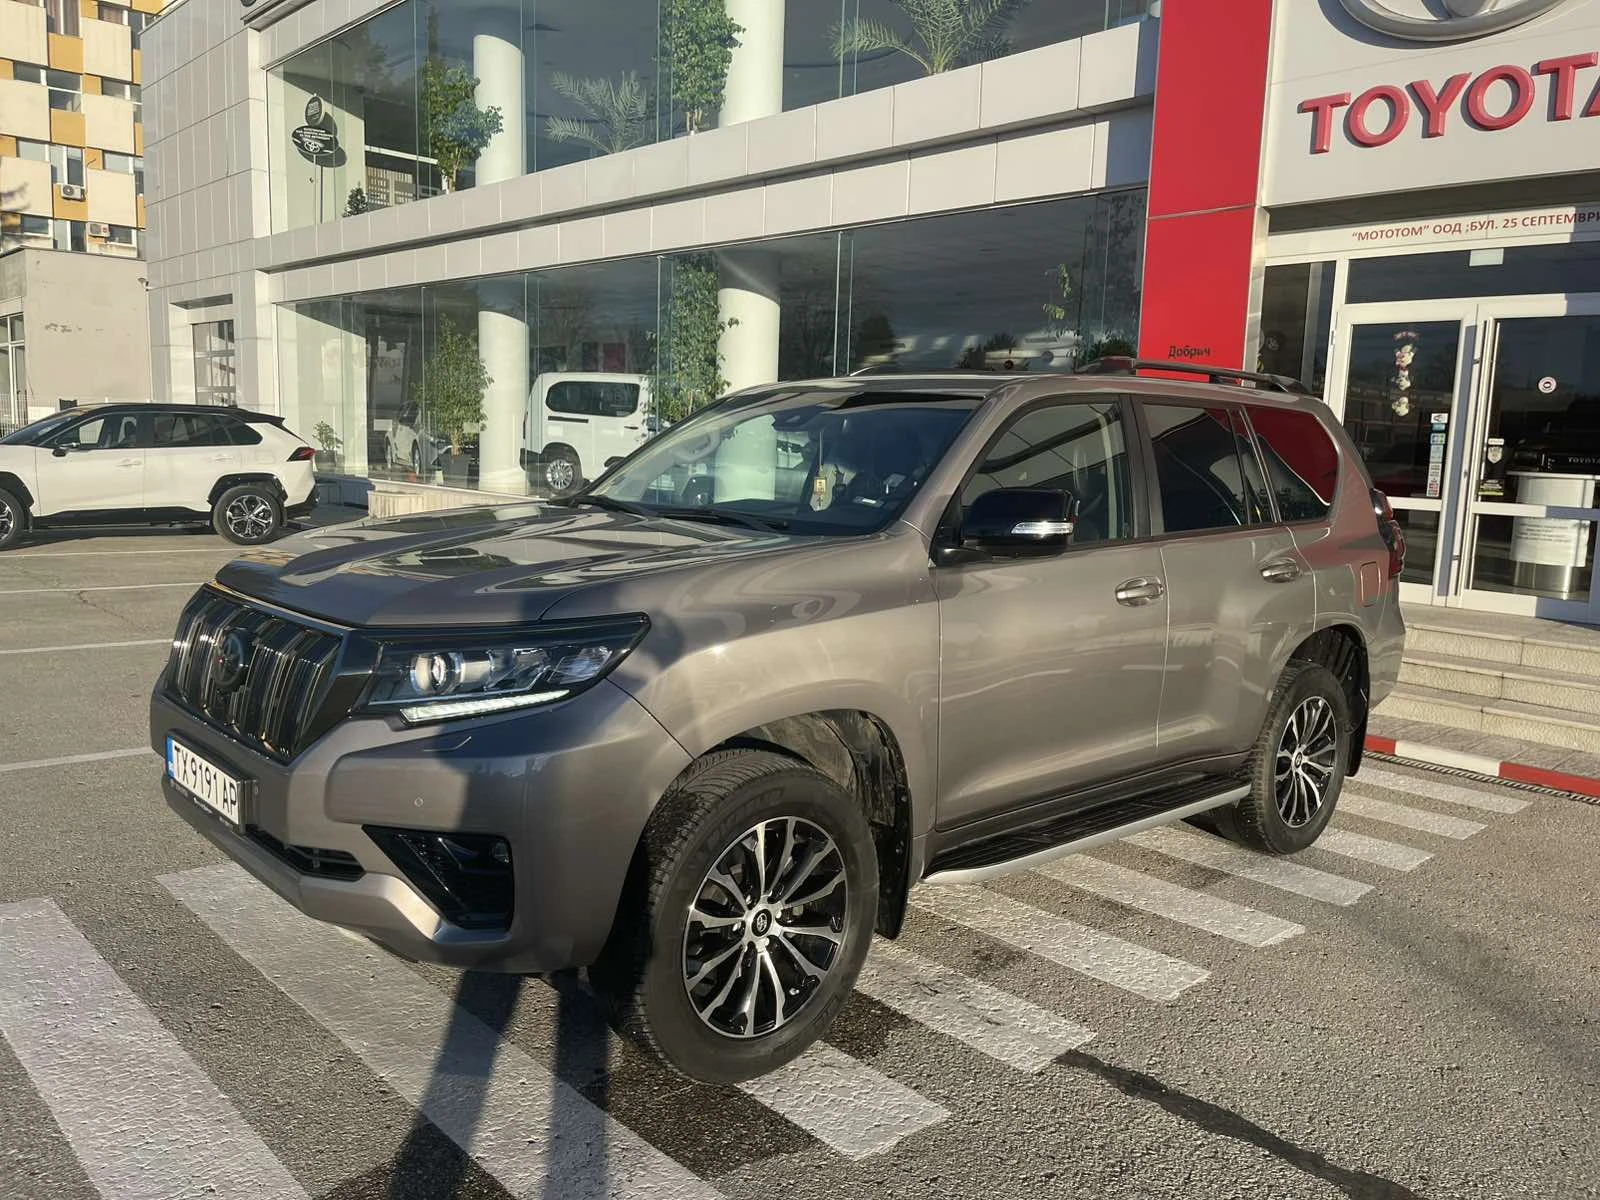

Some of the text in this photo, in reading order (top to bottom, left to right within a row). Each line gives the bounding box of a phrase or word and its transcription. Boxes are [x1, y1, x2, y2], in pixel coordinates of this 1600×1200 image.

[1432, 222, 1462, 235] ООД
[1502, 217, 1518, 229] 25
[1168, 344, 1211, 359] Добрич
